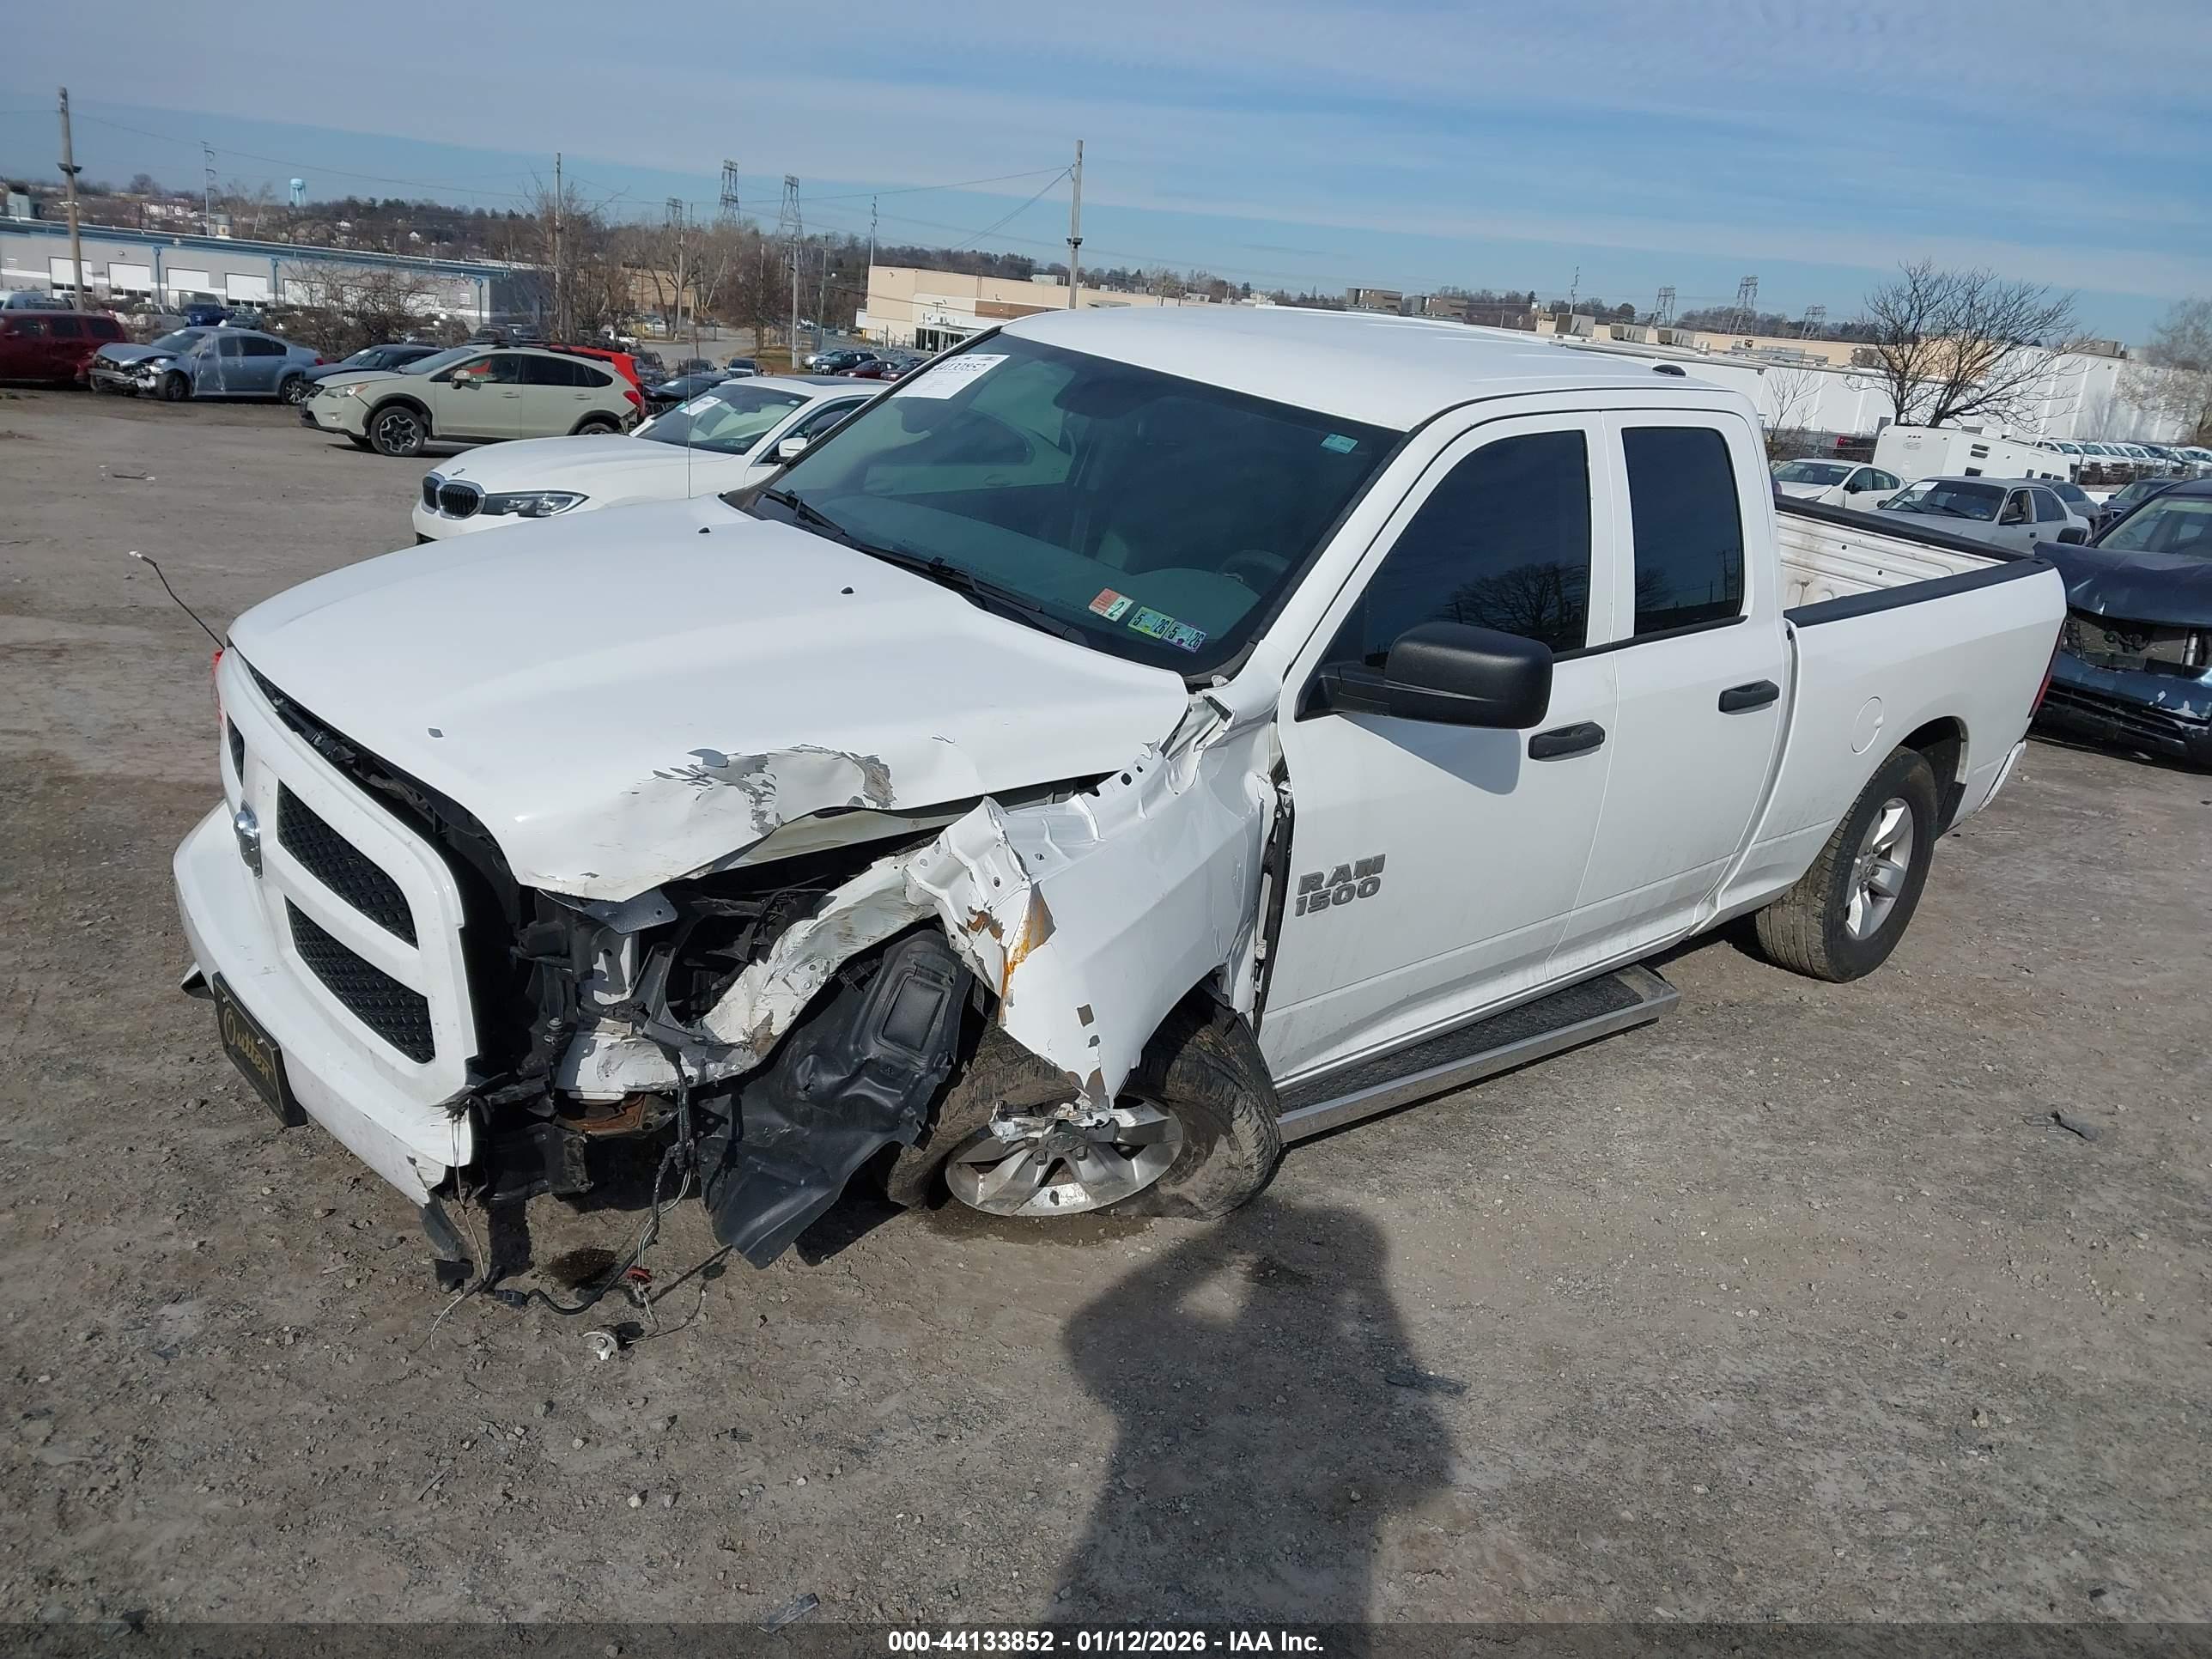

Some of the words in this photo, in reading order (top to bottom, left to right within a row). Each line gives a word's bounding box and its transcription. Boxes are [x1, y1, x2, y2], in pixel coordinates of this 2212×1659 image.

[1107, 600, 1125, 618] 2
[1154, 618, 1170, 635] 26
[1188, 631, 1206, 648] 26
[1297, 854, 1386, 895] RAM
[1295, 876, 1382, 917] 1500
